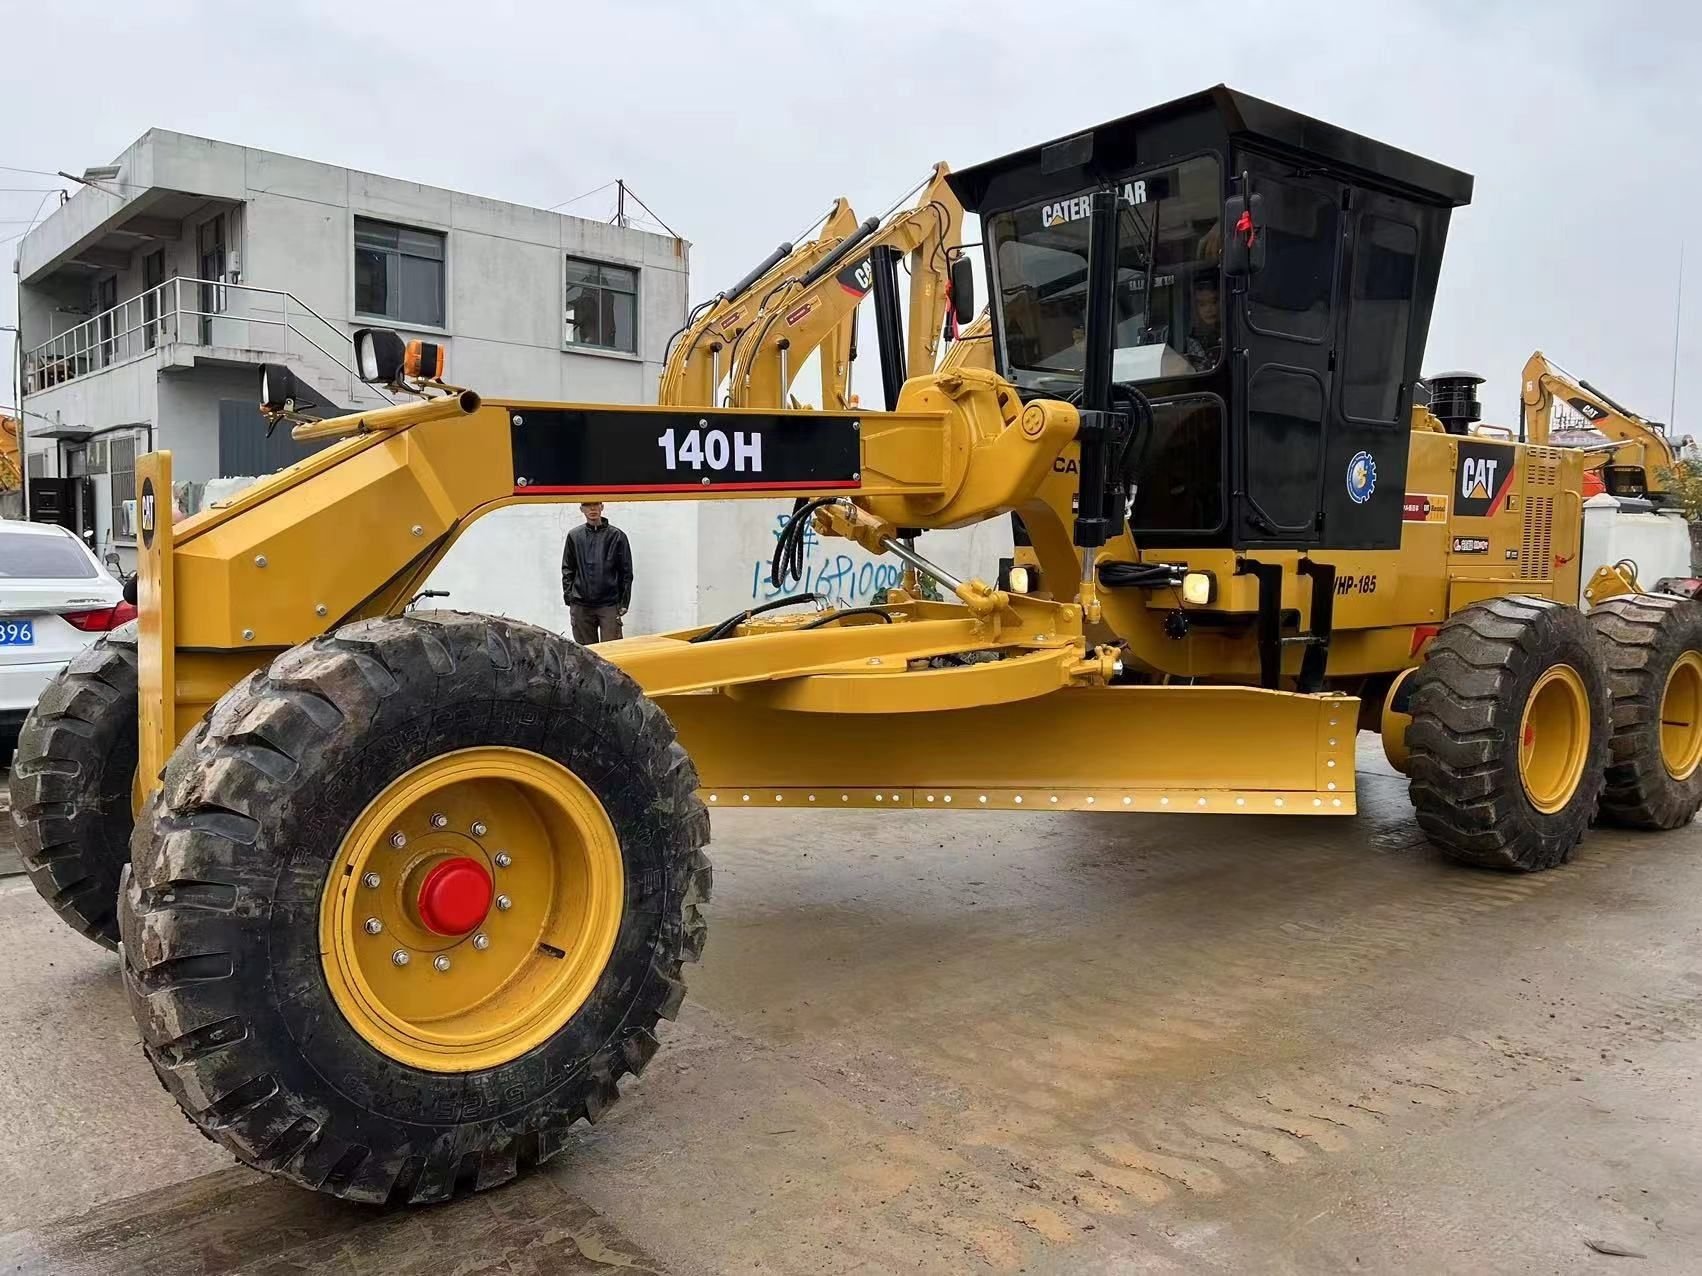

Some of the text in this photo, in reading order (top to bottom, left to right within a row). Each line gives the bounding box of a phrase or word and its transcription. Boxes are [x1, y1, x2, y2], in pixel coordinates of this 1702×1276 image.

[1042, 180, 1147, 228] CATERAR
[854, 257, 872, 289] CA
[1581, 404, 1599, 418] CAT
[658, 428, 762, 472] 140H
[1053, 456, 1081, 474] CA
[1462, 457, 1498, 499] CAT
